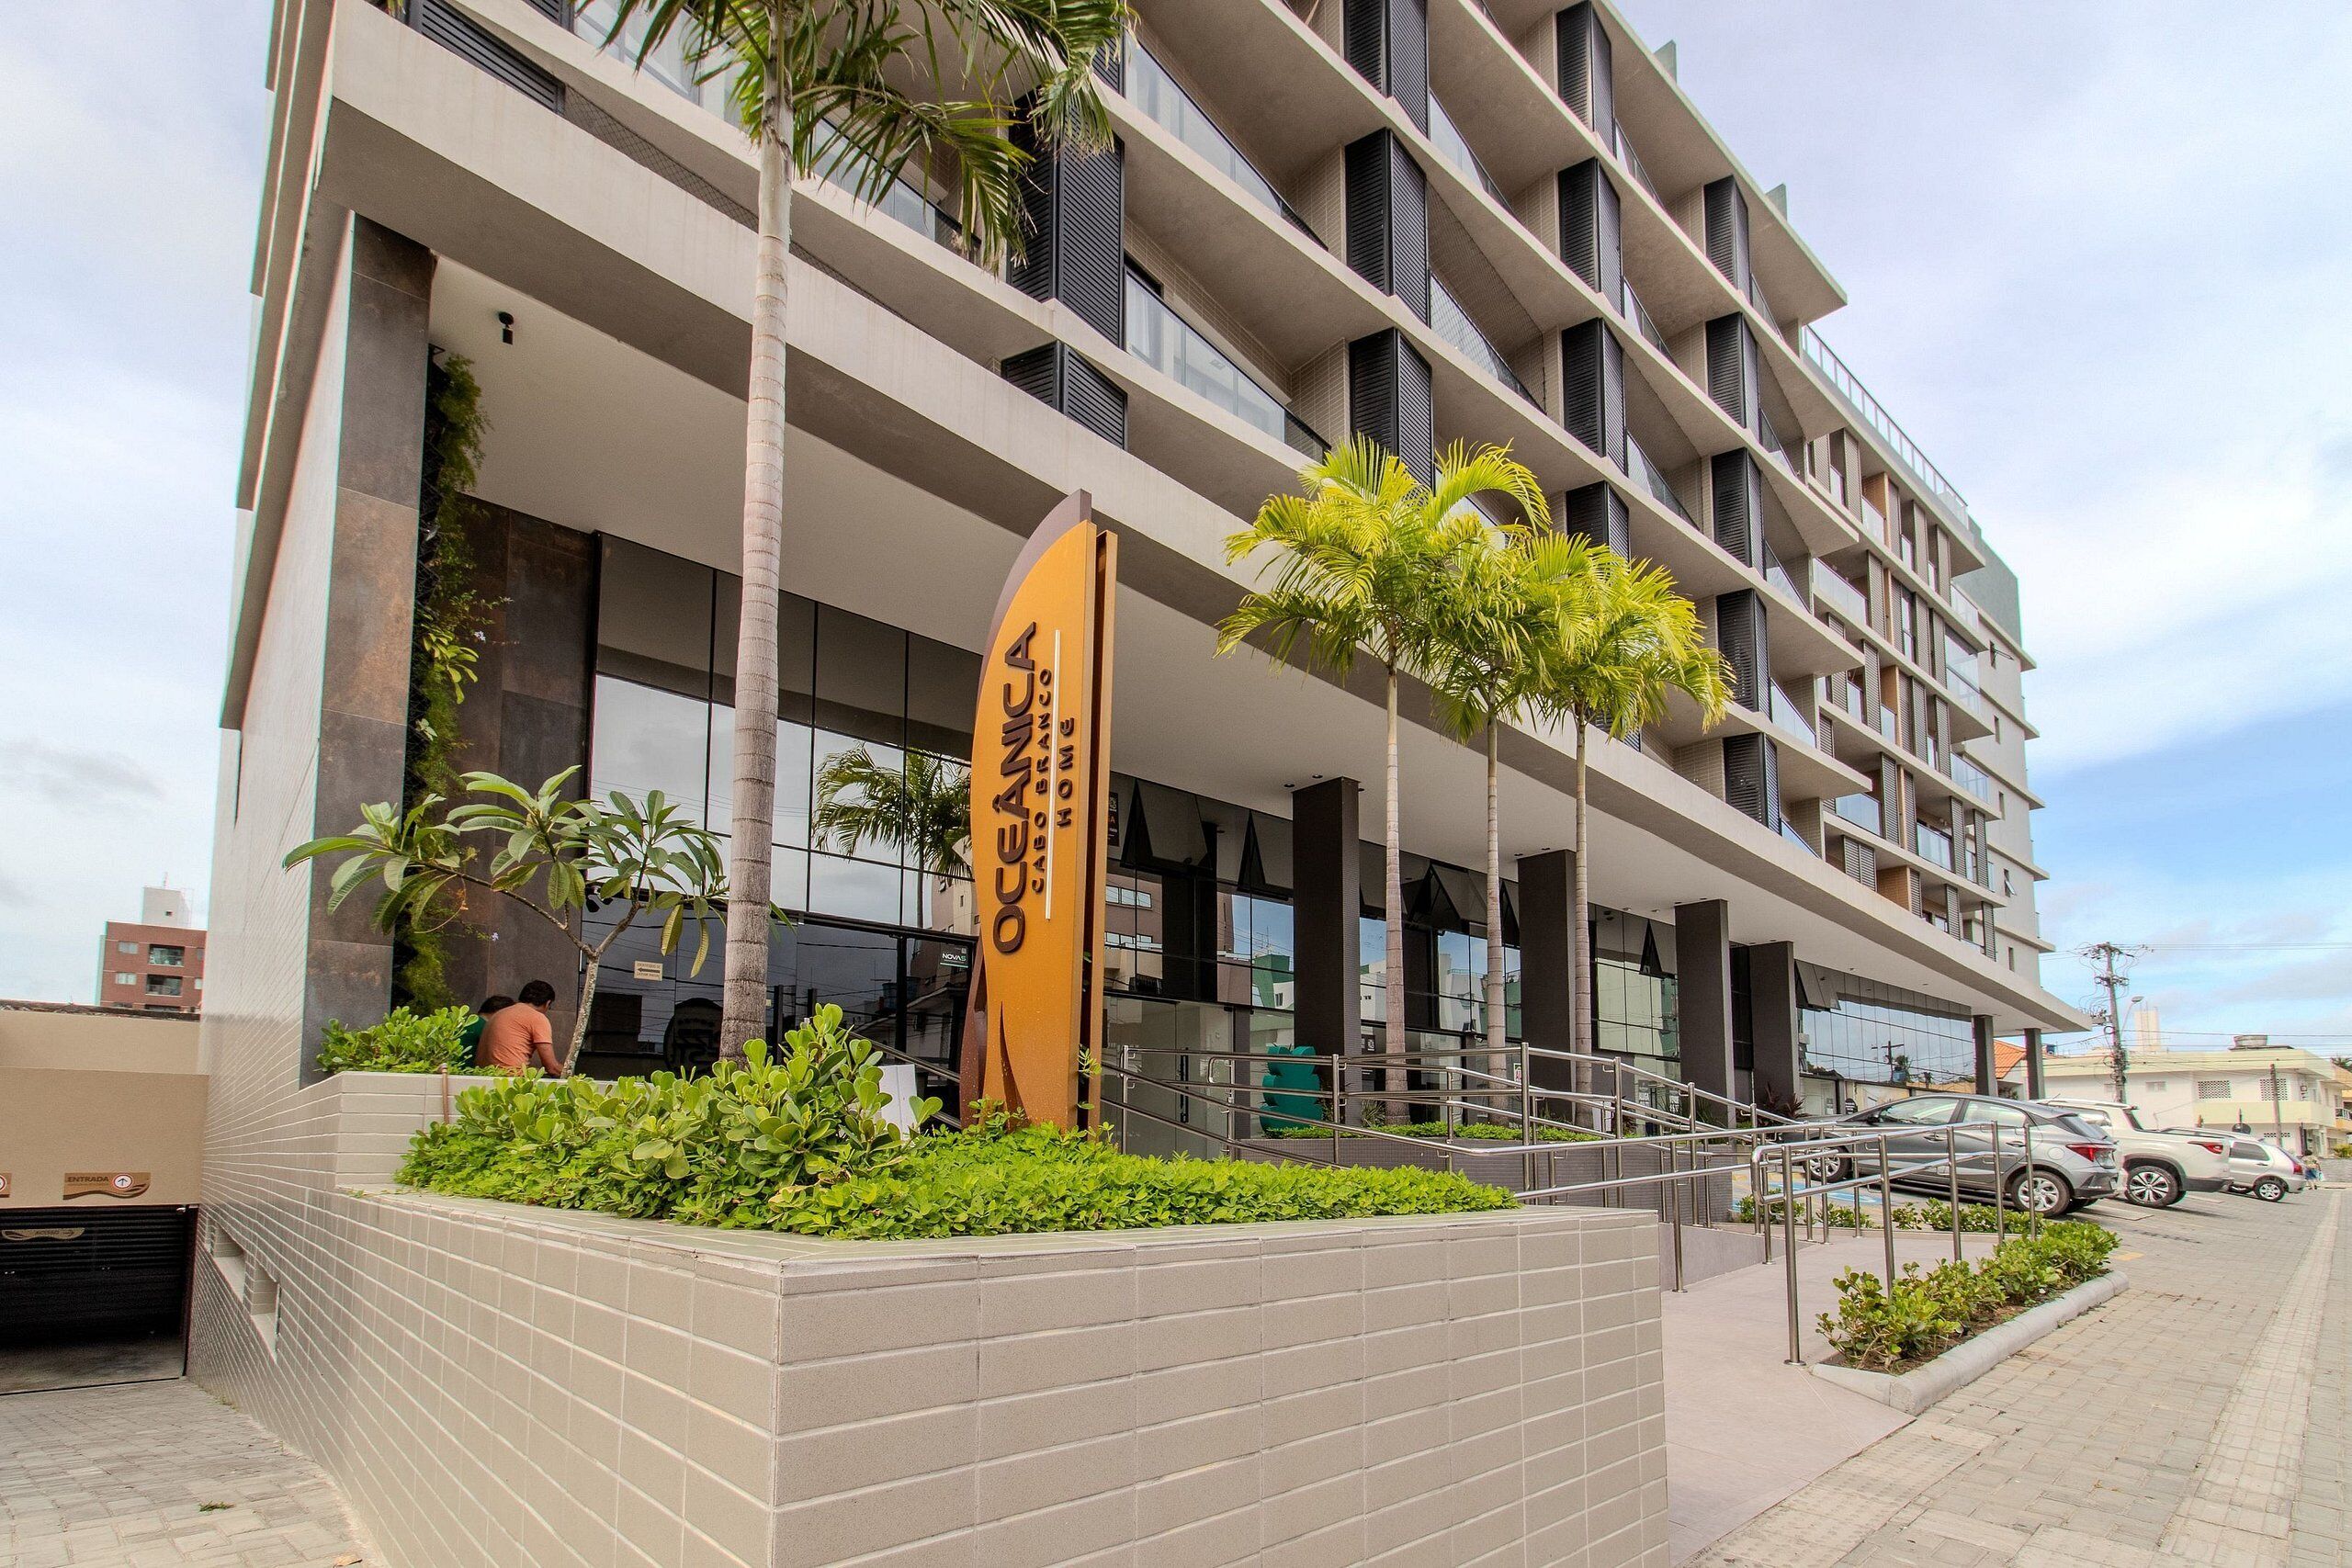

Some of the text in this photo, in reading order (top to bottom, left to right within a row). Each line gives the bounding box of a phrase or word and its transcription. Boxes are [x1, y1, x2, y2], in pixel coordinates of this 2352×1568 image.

[992, 621, 1036, 953] OCEÂNICA
[1031, 669, 1051, 893] CABO BRANCO
[1057, 717, 1075, 827] HOME
